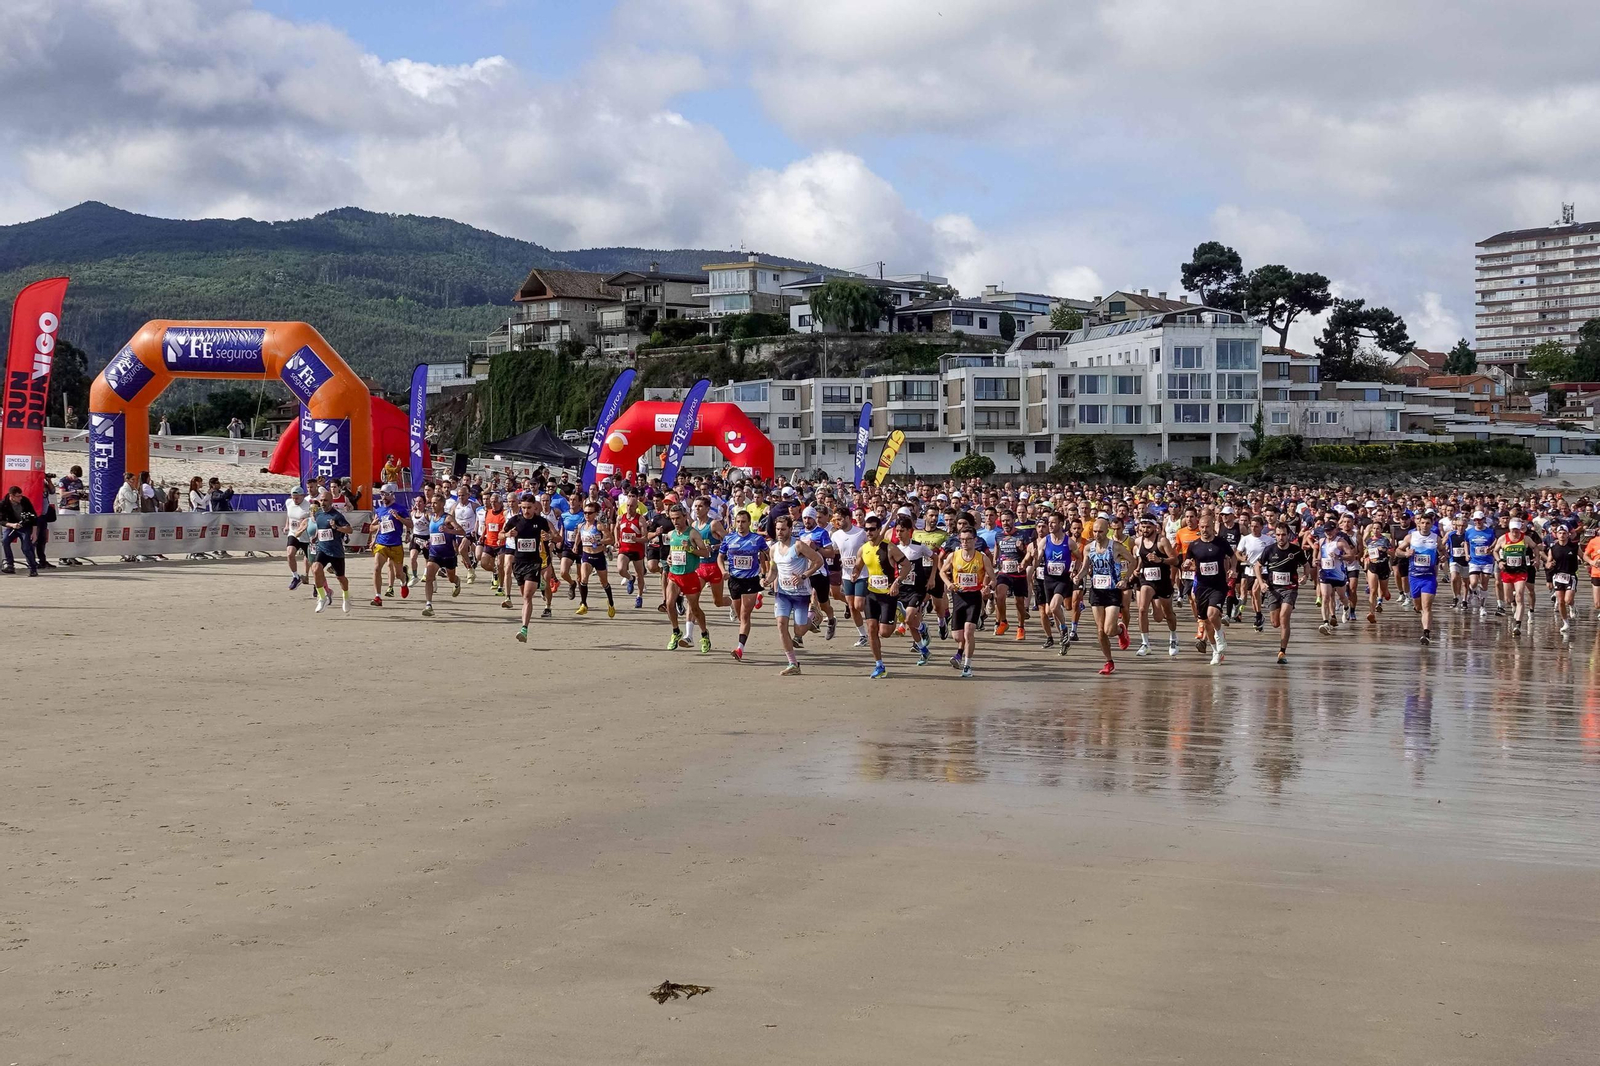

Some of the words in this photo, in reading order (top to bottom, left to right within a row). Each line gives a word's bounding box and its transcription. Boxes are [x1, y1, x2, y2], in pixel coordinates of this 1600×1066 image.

[32, 311, 58, 380] VIGO
[188, 336, 213, 358] FE
[216, 349, 258, 362] seguros
[120, 362, 143, 386] seguros
[290, 372, 312, 397] seguros
[297, 365, 316, 387] FE
[7, 371, 29, 429] RUN
[604, 390, 622, 425] seguros
[672, 427, 688, 450] FE
[684, 398, 698, 430] seguros
[94, 441, 114, 468] FE
[318, 448, 338, 477] FE
[93, 472, 103, 514] seguro
